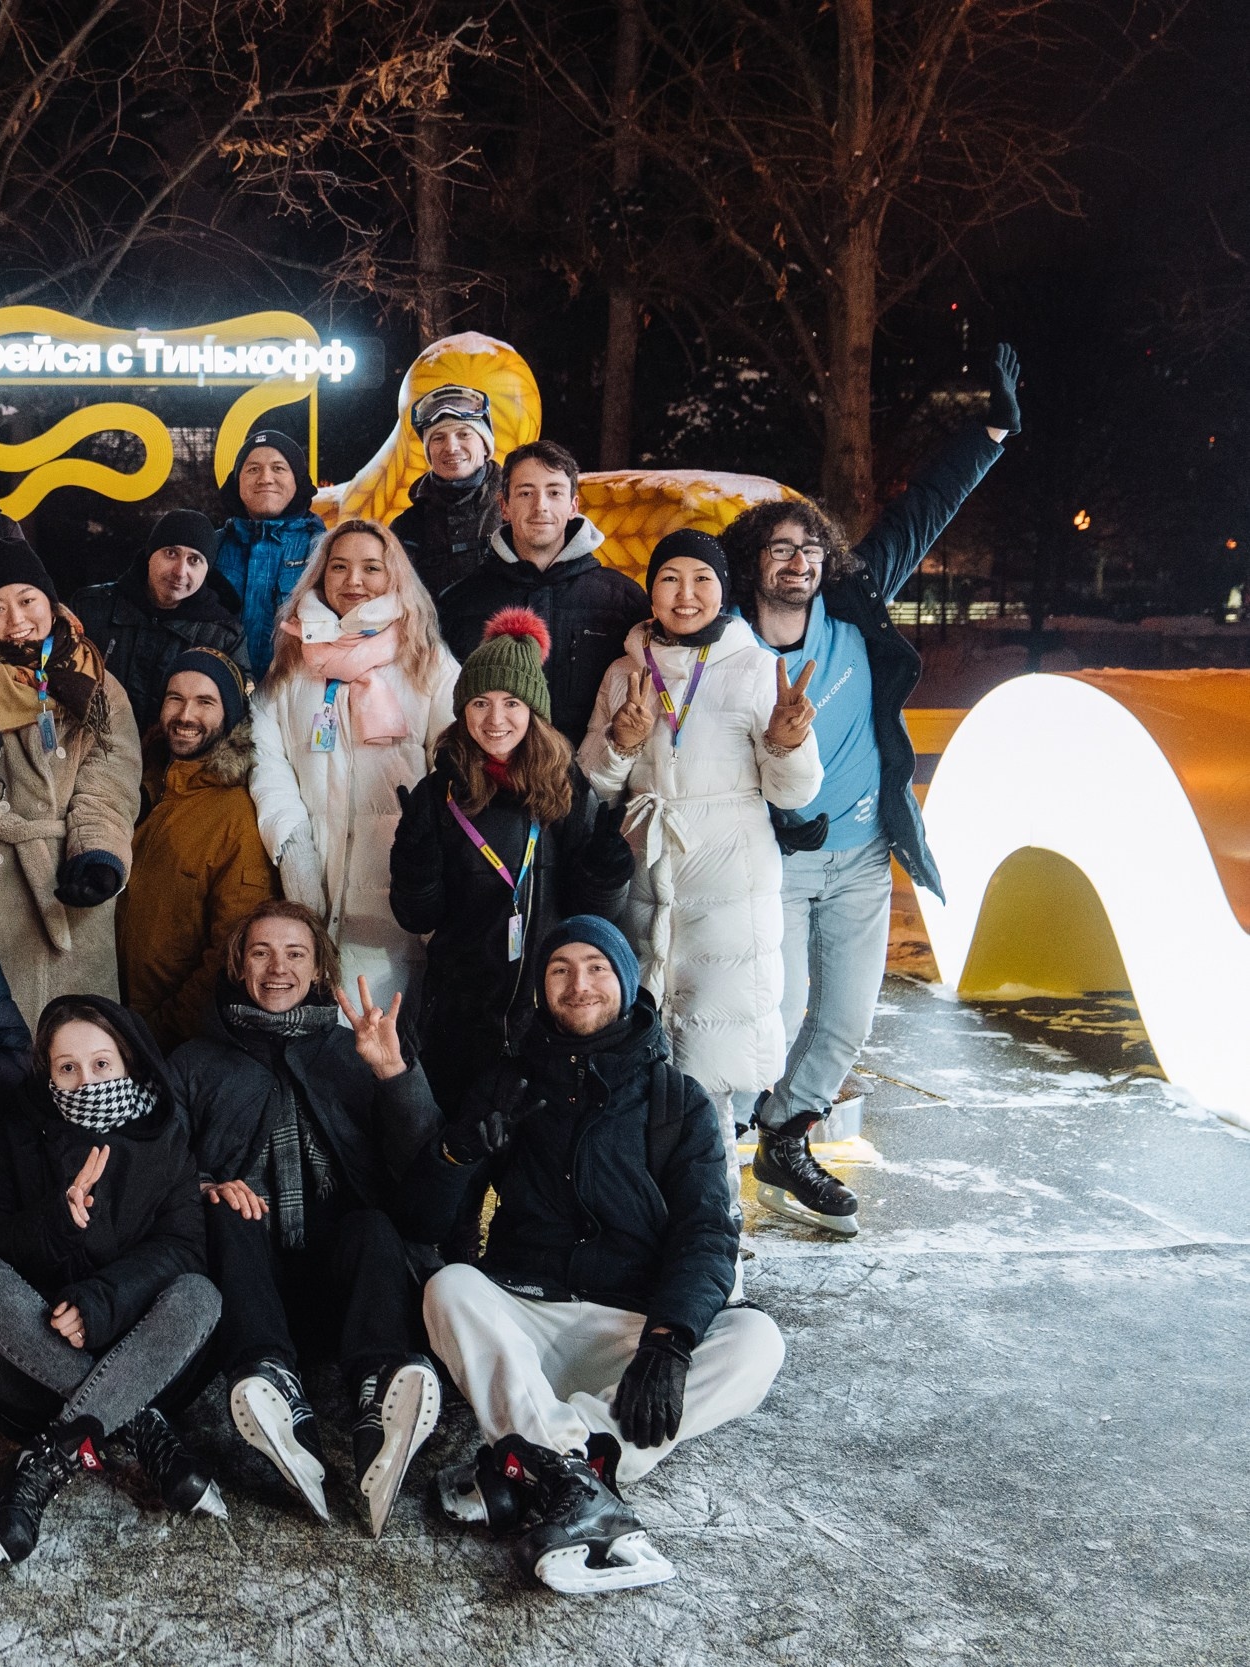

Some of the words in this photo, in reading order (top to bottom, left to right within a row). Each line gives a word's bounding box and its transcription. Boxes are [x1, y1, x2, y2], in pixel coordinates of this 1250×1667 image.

[107, 342, 134, 375] с
[137, 336, 357, 382] Тинькофф
[817, 694, 831, 709] КАК
[831, 667, 853, 694] СЕНЬОР
